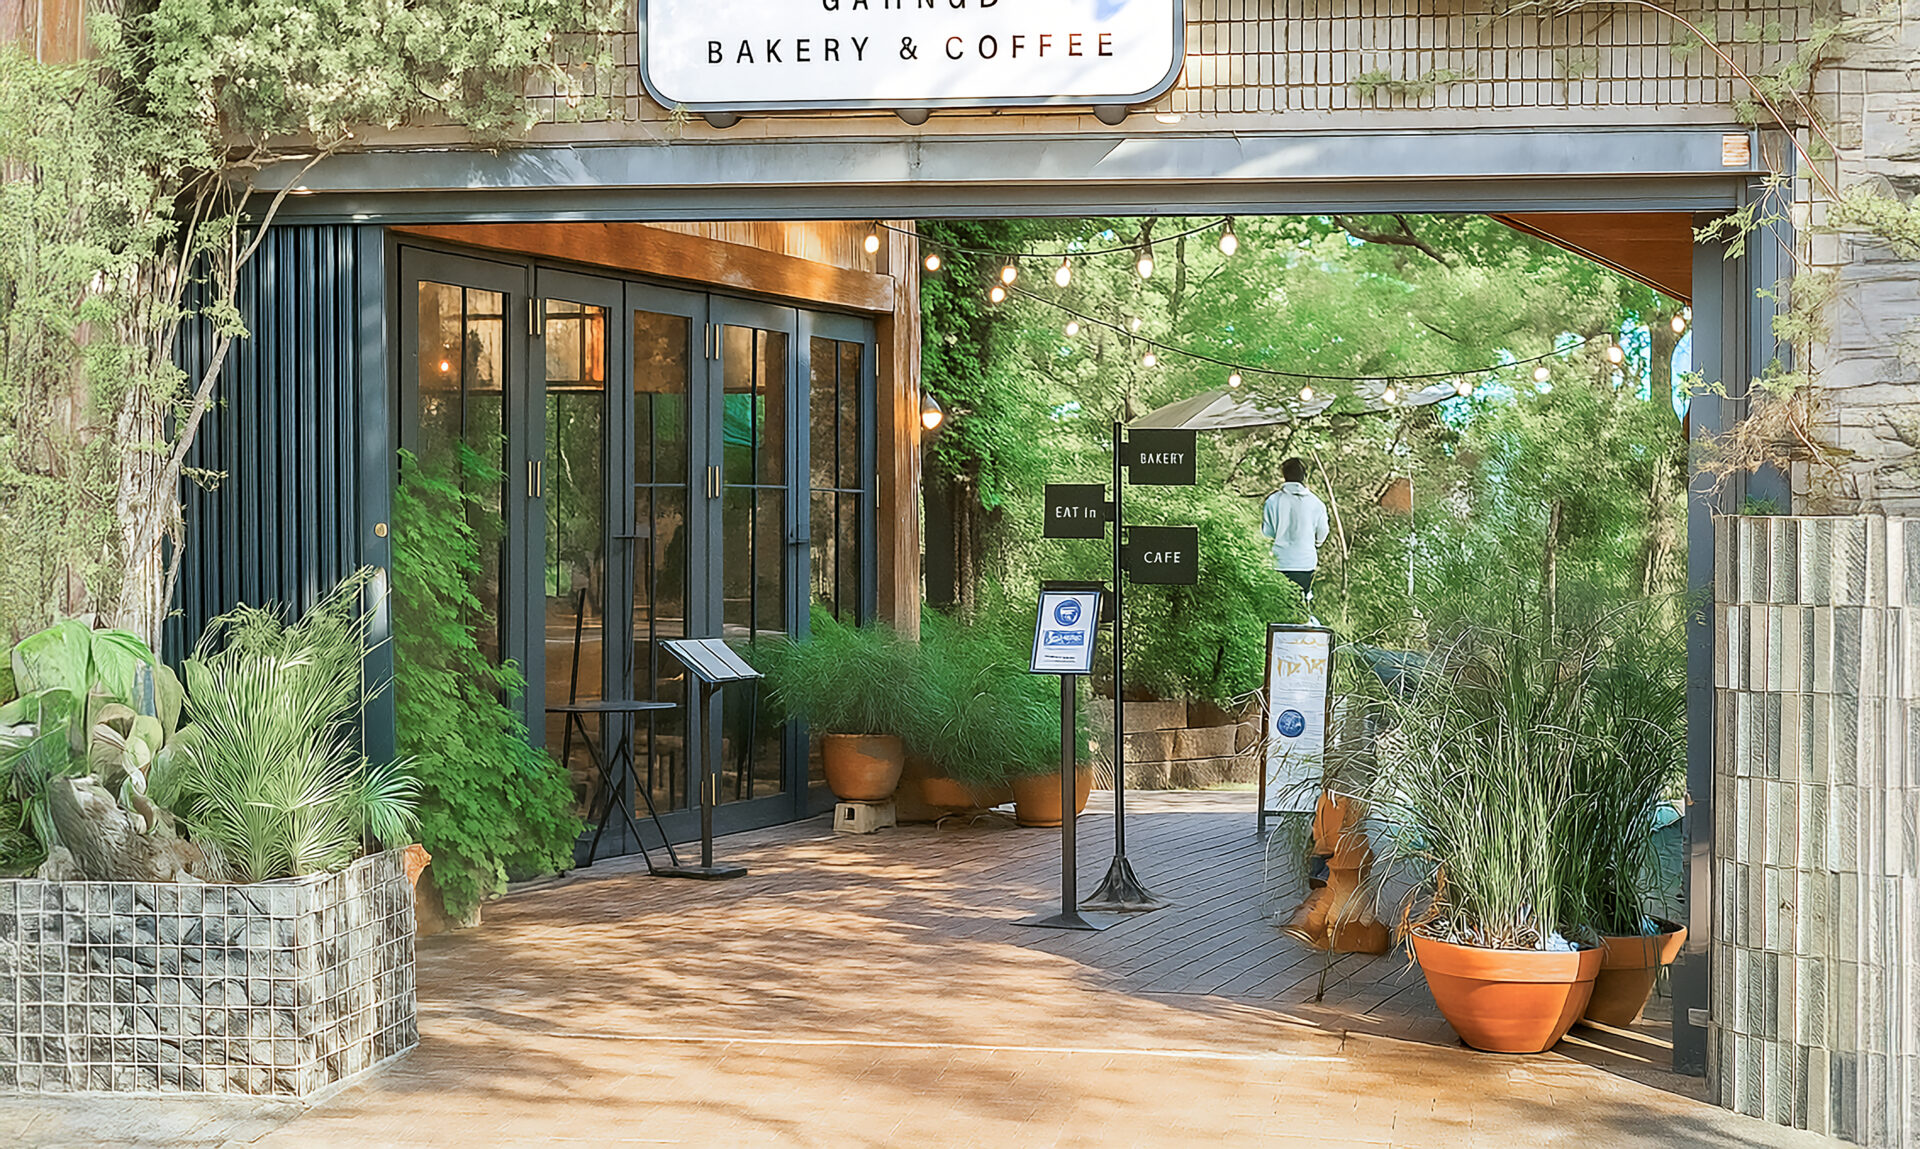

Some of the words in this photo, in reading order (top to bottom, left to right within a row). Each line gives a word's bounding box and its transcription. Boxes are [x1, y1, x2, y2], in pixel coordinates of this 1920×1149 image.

[707, 36, 869, 64] BAKERY
[899, 36, 918, 61] &
[945, 32, 1113, 61] COFFEE
[1140, 452, 1185, 465] BAKERY
[1055, 505, 1080, 519] EAT
[1143, 551, 1181, 564] CAFE
